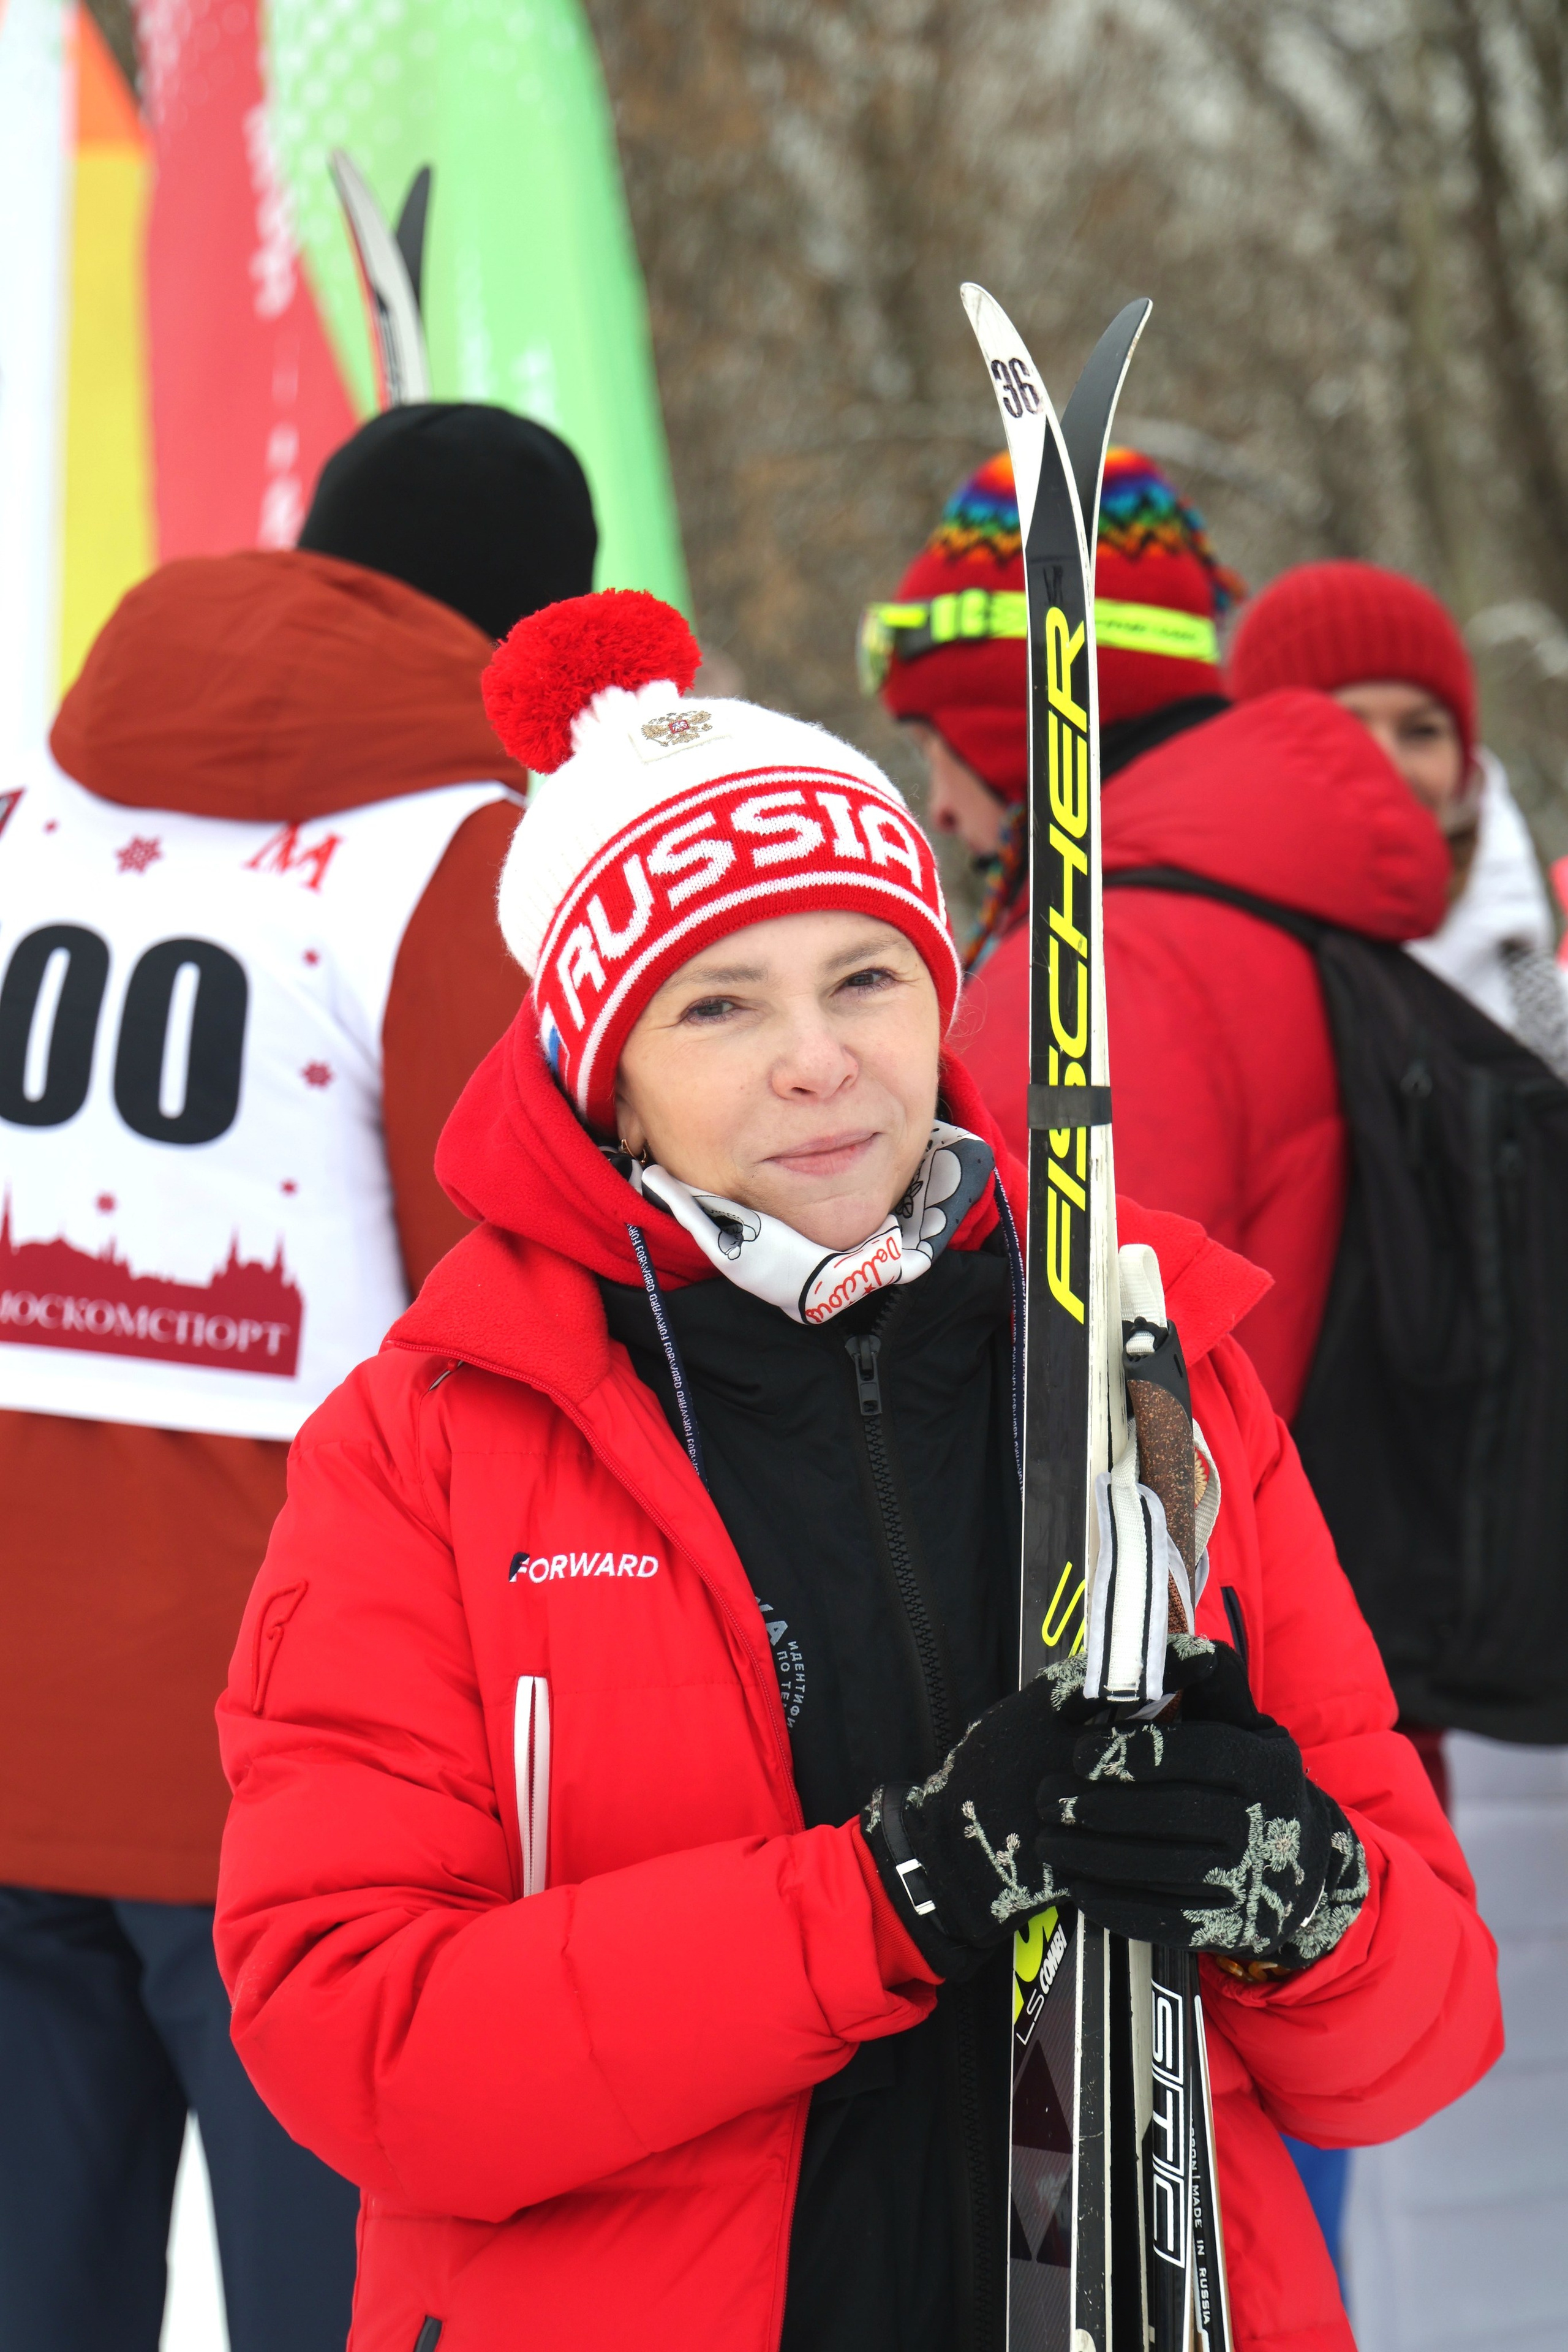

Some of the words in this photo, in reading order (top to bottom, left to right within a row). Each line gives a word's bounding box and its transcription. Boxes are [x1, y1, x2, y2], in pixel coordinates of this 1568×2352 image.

[991, 358, 1041, 418] 36
[556, 790, 922, 1031] RUSSIA
[1047, 606, 1087, 1325] FISCHER
[635, 1245, 655, 1292] FORWARD
[649, 1293, 669, 1341] FORWARD
[663, 1341, 682, 1389] FORWARD
[676, 1390, 693, 1437] FORWARD
[508, 1551, 659, 1583] FORWARD
[777, 1650, 790, 1672] ПО
[788, 1640, 805, 1733] ИДЕНТИФИ
[1016, 1989, 1044, 2045] LS
[1039, 1923, 1068, 1994] COMBI
[1192, 2184, 1202, 2228] MADE
[1196, 2239, 1205, 2256] IN
[1199, 2267, 1211, 2325] RUSSIA
